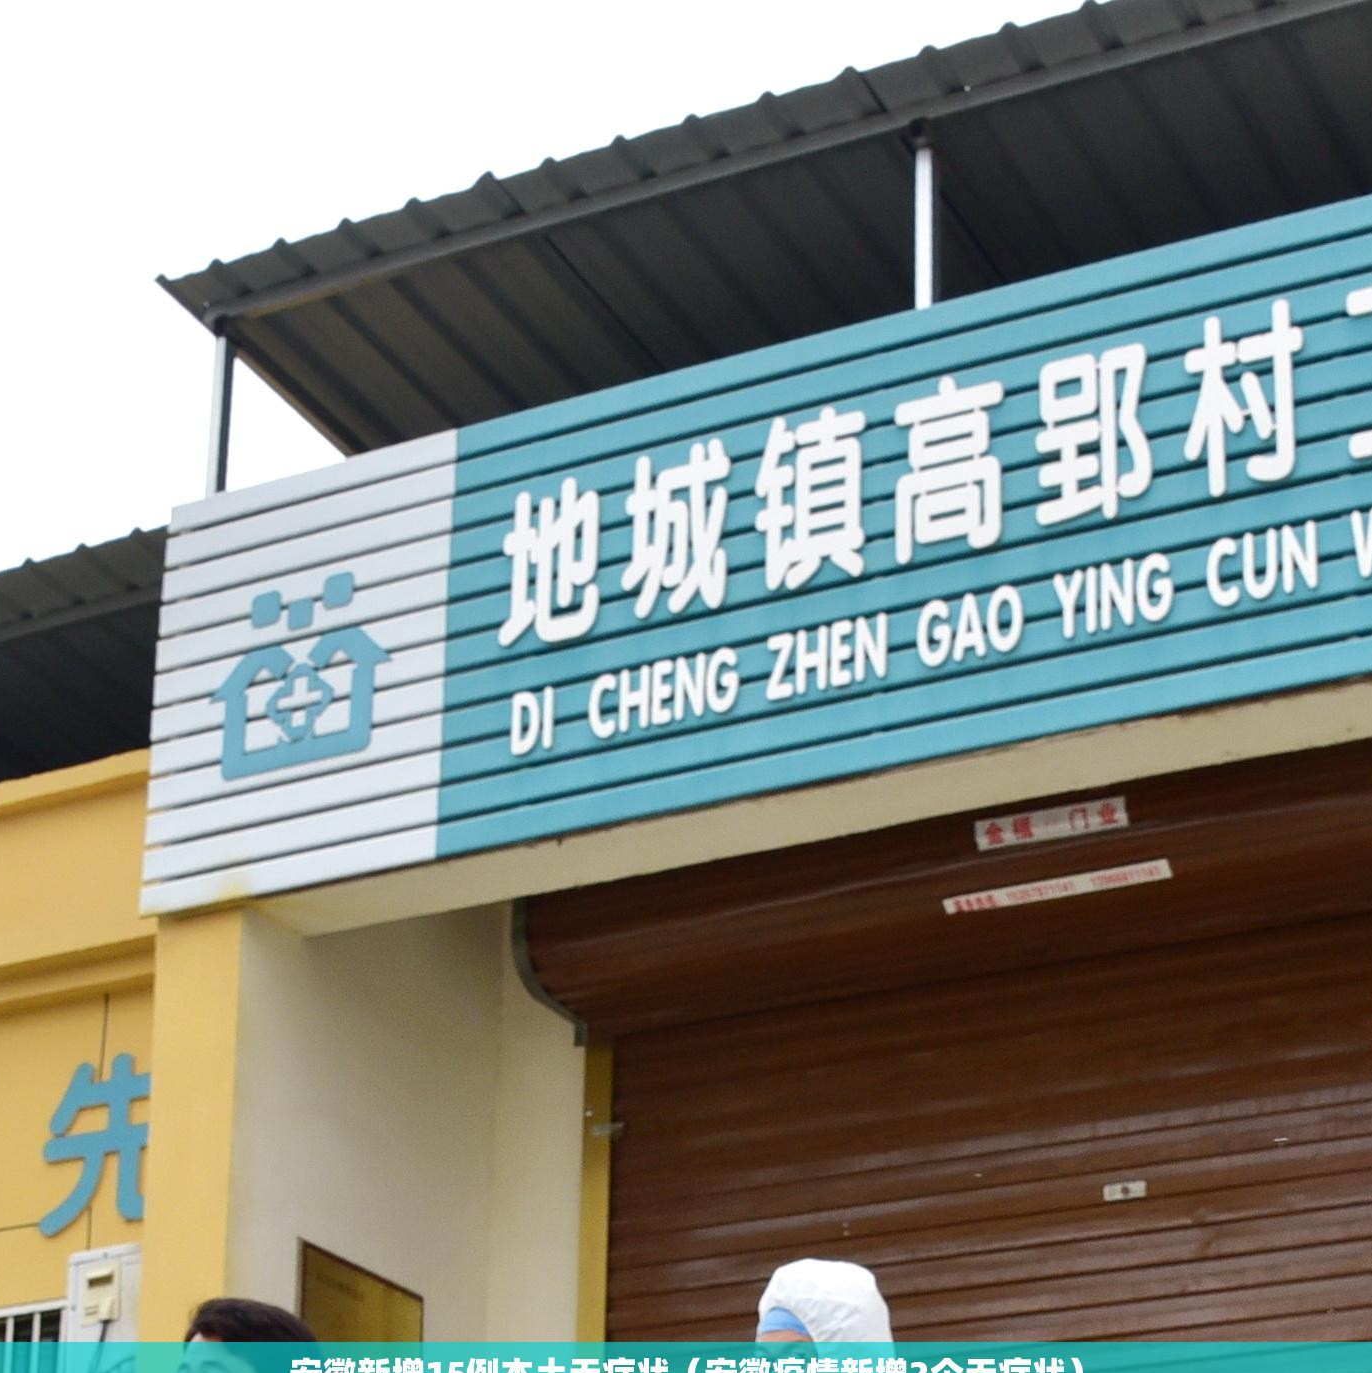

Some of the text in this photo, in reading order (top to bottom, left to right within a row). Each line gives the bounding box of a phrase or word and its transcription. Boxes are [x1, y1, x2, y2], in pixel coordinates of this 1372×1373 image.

[510, 685, 555, 756] DI
[588, 648, 740, 739] CHENG
[766, 612, 890, 701] ZHEN
[916, 584, 1024, 667] GAO
[1052, 553, 1175, 638] YING
[1206, 520, 1319, 607] CUN
